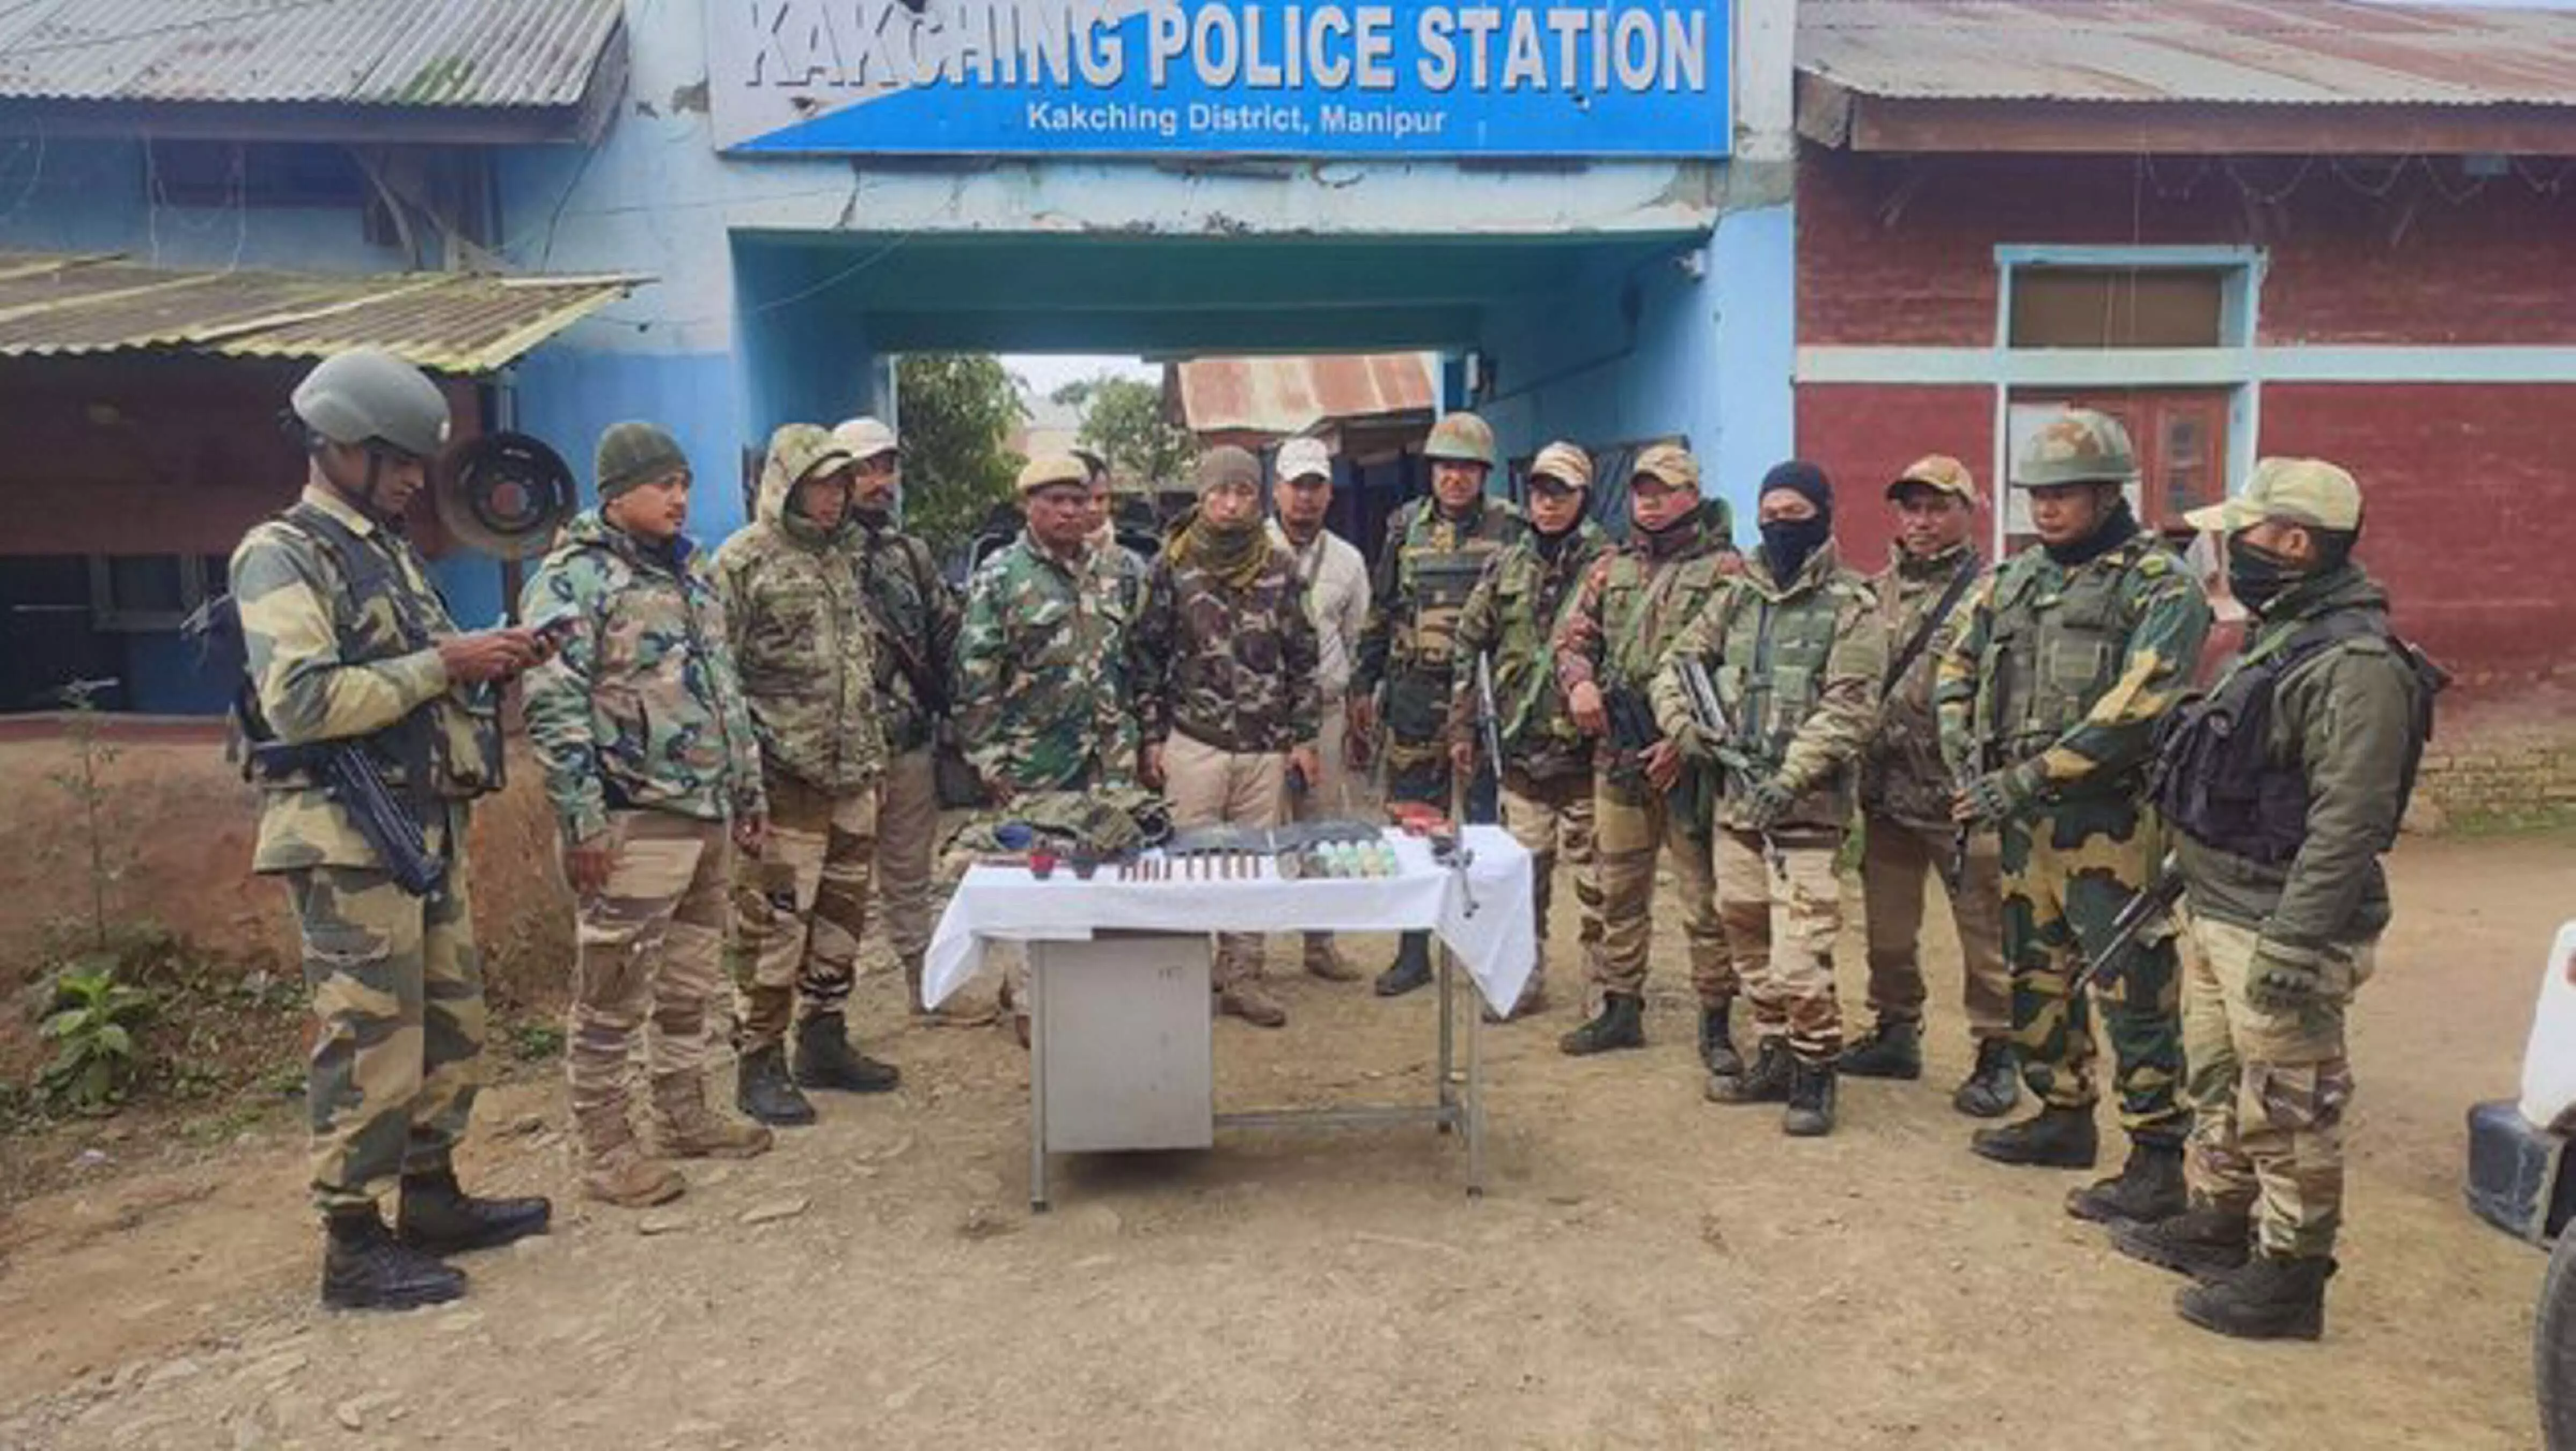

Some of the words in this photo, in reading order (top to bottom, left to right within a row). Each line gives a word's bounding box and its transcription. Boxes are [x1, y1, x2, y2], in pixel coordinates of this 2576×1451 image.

[745, 0, 1124, 89] KAKCHING
[1147, 2, 1394, 89] POLICE
[1417, 6, 1706, 93] STATION
[1027, 104, 1177, 135] Kakching
[1189, 104, 1309, 134] District,
[1320, 105, 1446, 137] Manipur
